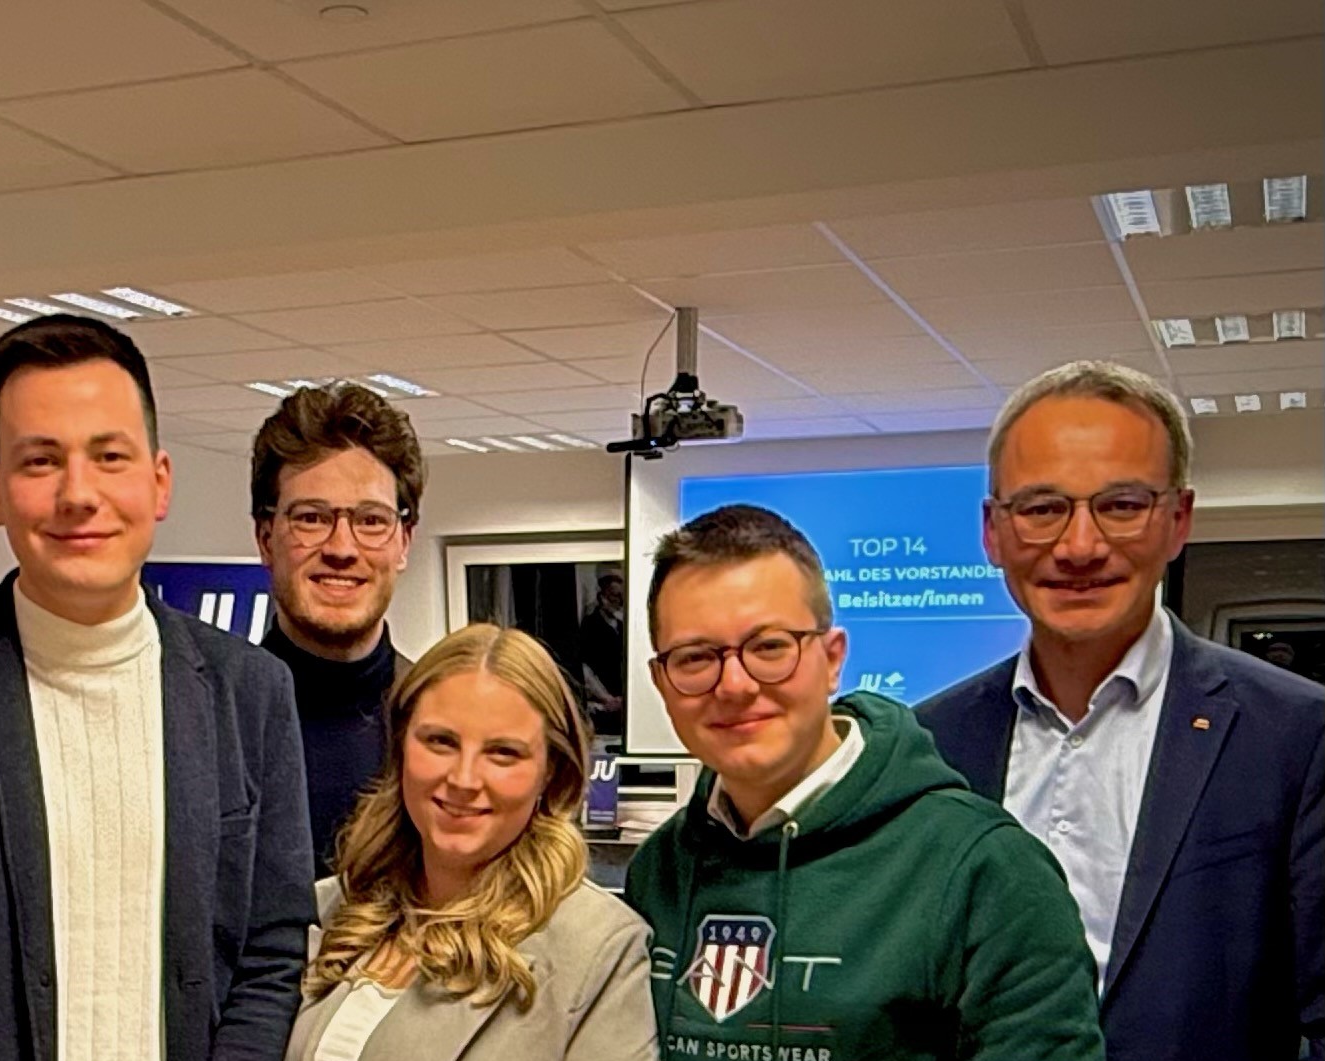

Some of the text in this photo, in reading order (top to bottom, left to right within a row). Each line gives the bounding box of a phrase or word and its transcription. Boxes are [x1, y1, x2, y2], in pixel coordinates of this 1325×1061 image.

[849, 535, 928, 557] TOP 14
[858, 567, 892, 582] DES
[838, 589, 985, 608] Beisitzer/innen
[589, 760, 617, 782] JU
[707, 925, 763, 942] 1949
